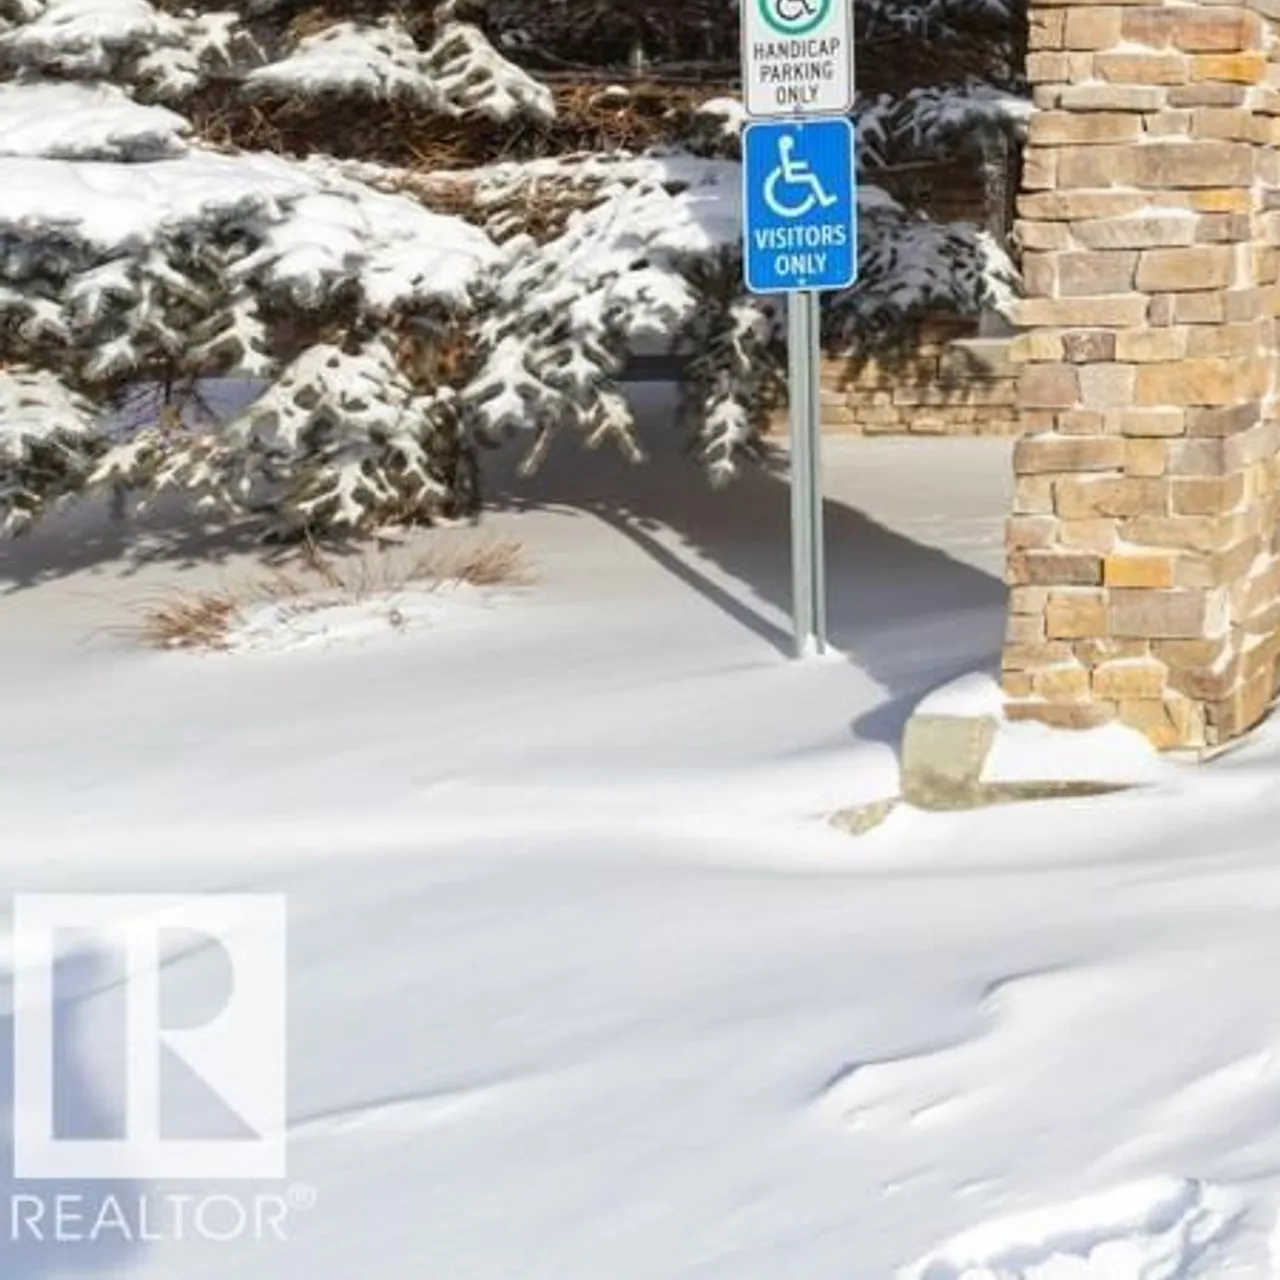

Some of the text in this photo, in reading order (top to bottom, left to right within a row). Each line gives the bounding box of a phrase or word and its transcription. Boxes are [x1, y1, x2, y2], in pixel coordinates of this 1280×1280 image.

[754, 37, 840, 60] HANDICAP
[760, 60, 834, 82] PARKING
[776, 84, 820, 105] ONLY
[754, 224, 846, 250] VISITORS
[775, 253, 827, 276] ONLY
